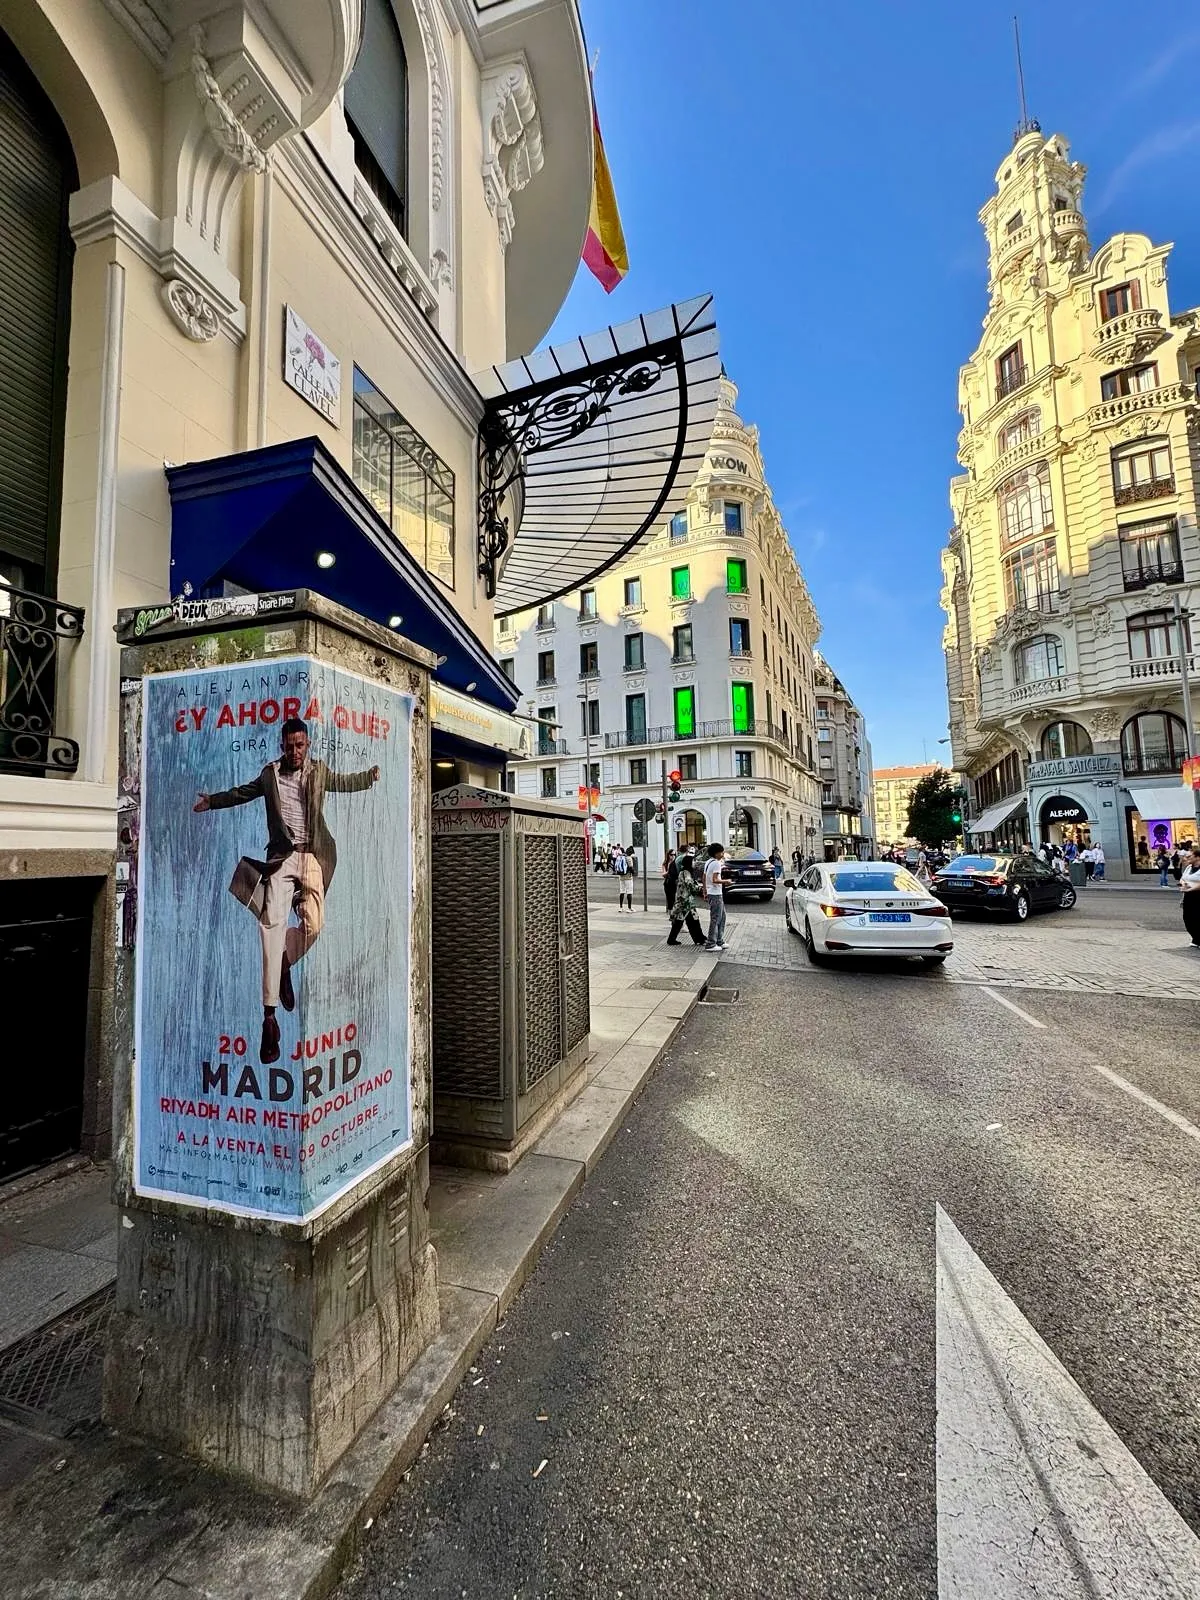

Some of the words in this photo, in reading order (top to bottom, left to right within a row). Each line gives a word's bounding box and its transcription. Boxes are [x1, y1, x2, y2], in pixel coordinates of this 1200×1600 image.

[292, 357, 323, 394] CALLE
[294, 373, 334, 420] CLAVEL
[709, 456, 748, 475] WOW
[182, 603, 208, 619] DEUK
[258, 599, 278, 610] Snare
[178, 671, 325, 698] ALEJANDRO
[344, 685, 391, 710] SANZ
[175, 705, 208, 733] ¿Y
[216, 695, 324, 729] AHORA
[333, 703, 391, 741] QUÉ?
[231, 737, 268, 752] GIRA
[321, 737, 368, 760] ESPAÑA
[1049, 808, 1080, 818] ALE-HOP
[863, 898, 871, 908] M
[218, 1035, 247, 1056] 20
[290, 1022, 358, 1061] JUNIO
[202, 1049, 362, 1104] MADRID
[160, 1097, 220, 1120] RIYADH
[226, 1102, 257, 1126] AIR
[263, 1069, 393, 1132] METROPOLITANO
[177, 1131, 186, 1144] A
[193, 1133, 209, 1147] LA
[216, 1136, 266, 1155] VENTA
[273, 1145, 292, 1160] EL
[298, 1143, 315, 1163] 09
[321, 1103, 379, 1149] OCTUBRE
